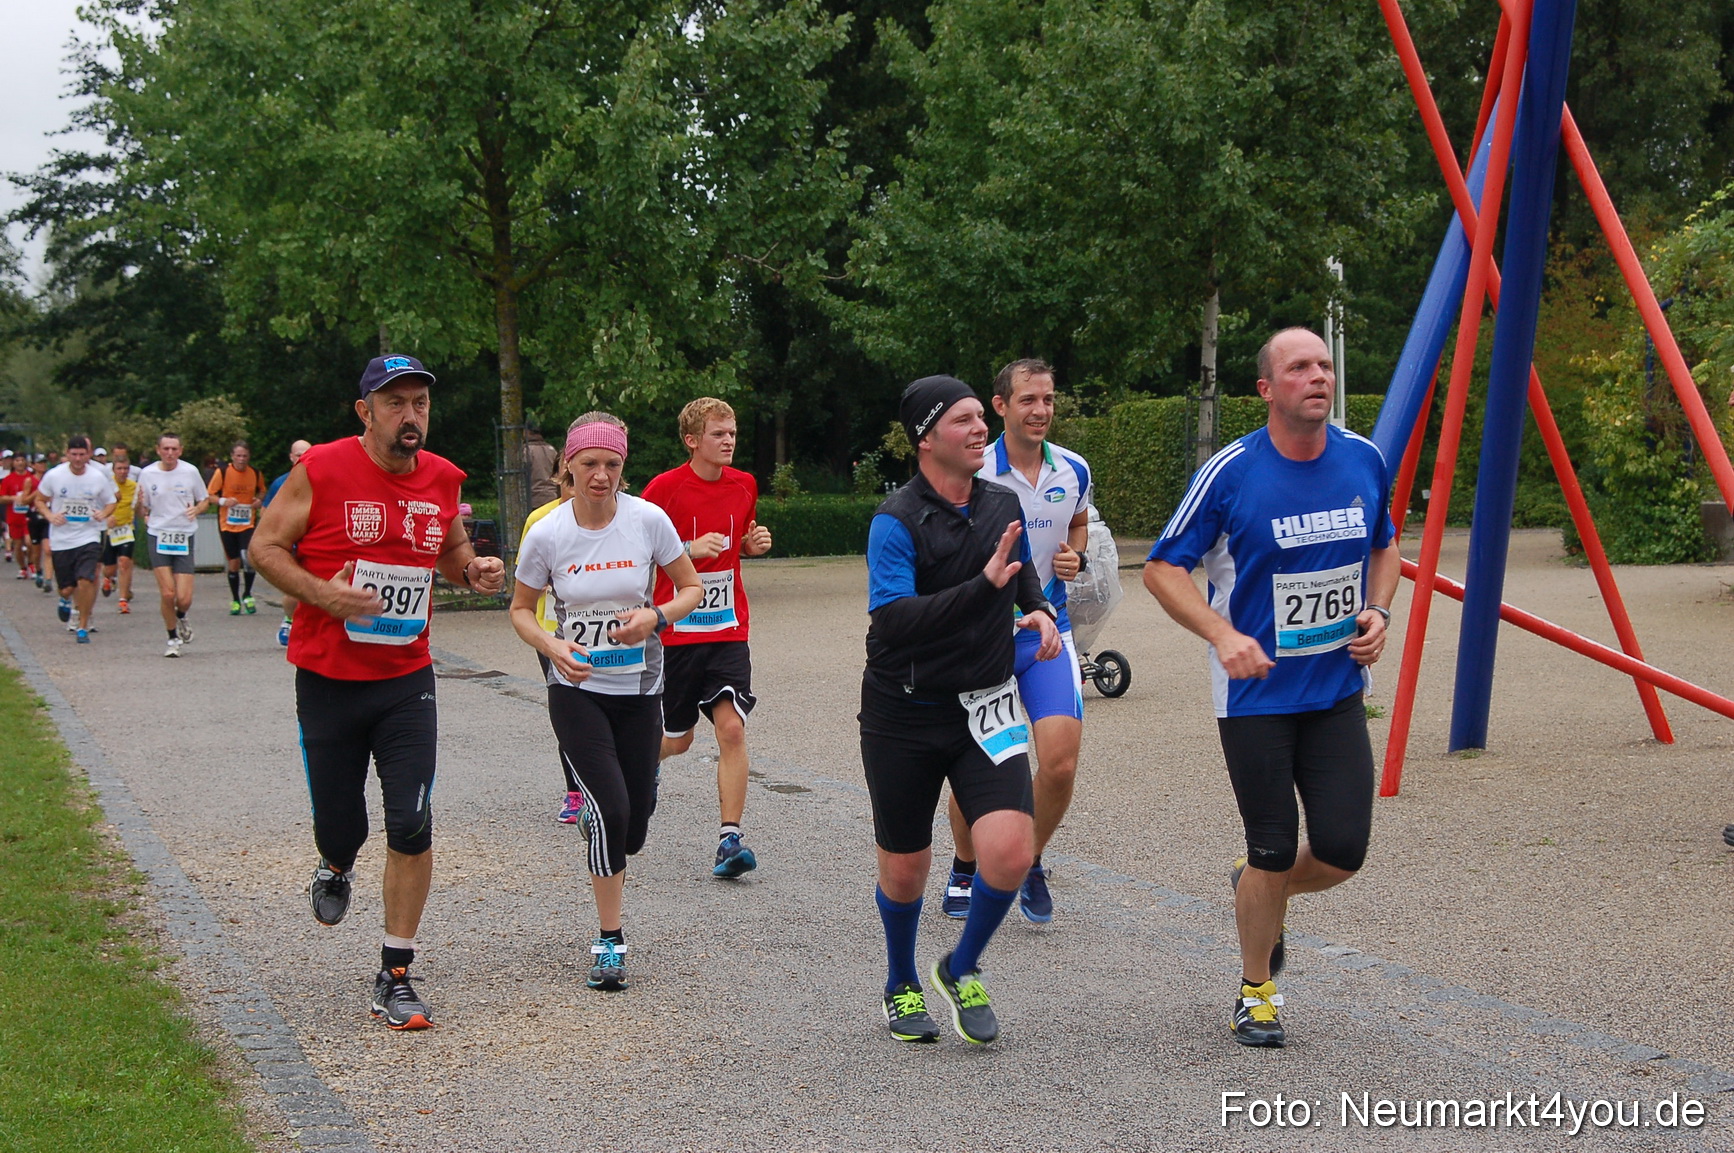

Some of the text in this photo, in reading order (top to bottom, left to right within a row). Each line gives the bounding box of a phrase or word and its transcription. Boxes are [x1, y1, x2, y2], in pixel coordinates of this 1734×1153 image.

[65, 505, 89, 516] 2492
[351, 506, 380, 515] IMMER
[350, 514, 382, 522] WIEDER
[1271, 507, 1366, 539] HUBER
[352, 521, 380, 532] NEU
[161, 532, 186, 544] 2183
[352, 531, 379, 539] MARKT
[1295, 528, 1364, 544] TECHNOLOGY
[585, 560, 637, 572] KLEBL
[356, 567, 423, 583] PARTL Neumarkt
[1276, 575, 1350, 591] PARTL Neumarkt
[1285, 585, 1355, 626] 2769
[689, 613, 723, 624] Matthias
[372, 620, 404, 634] Josef
[1297, 624, 1345, 646] Bernhard
[586, 653, 625, 665] Kerstin
